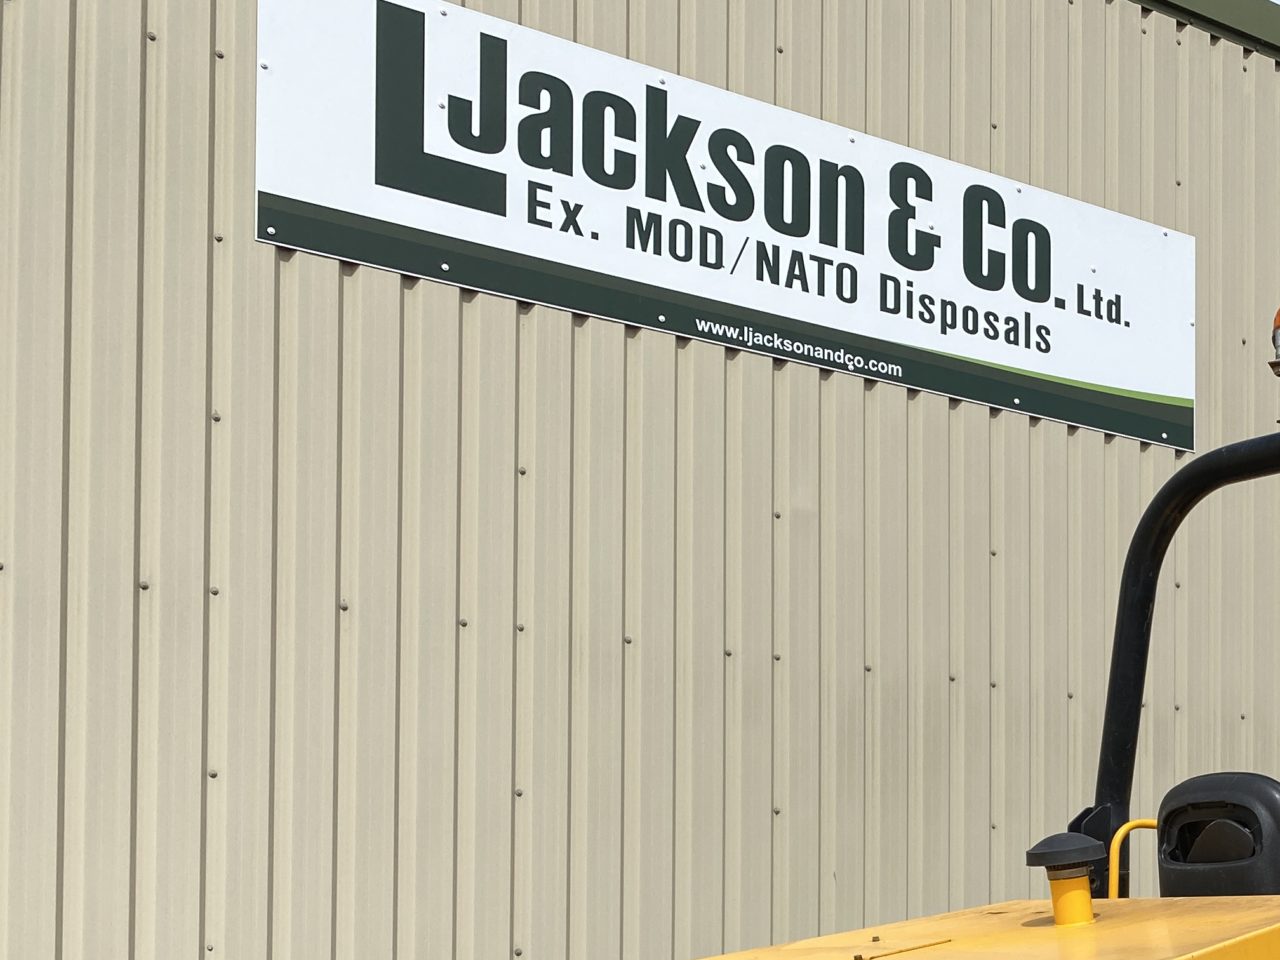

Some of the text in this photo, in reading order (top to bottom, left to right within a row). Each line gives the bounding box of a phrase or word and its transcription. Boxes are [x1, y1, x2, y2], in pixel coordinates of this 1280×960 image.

[527, 180, 1051, 353] Ex. MOD/NATO Disposals
[888, 161, 941, 271] &
[963, 184, 1066, 310] Co.
[1077, 284, 1130, 327] Ltd.
[695, 318, 903, 377] www.ljacksonandco.com
